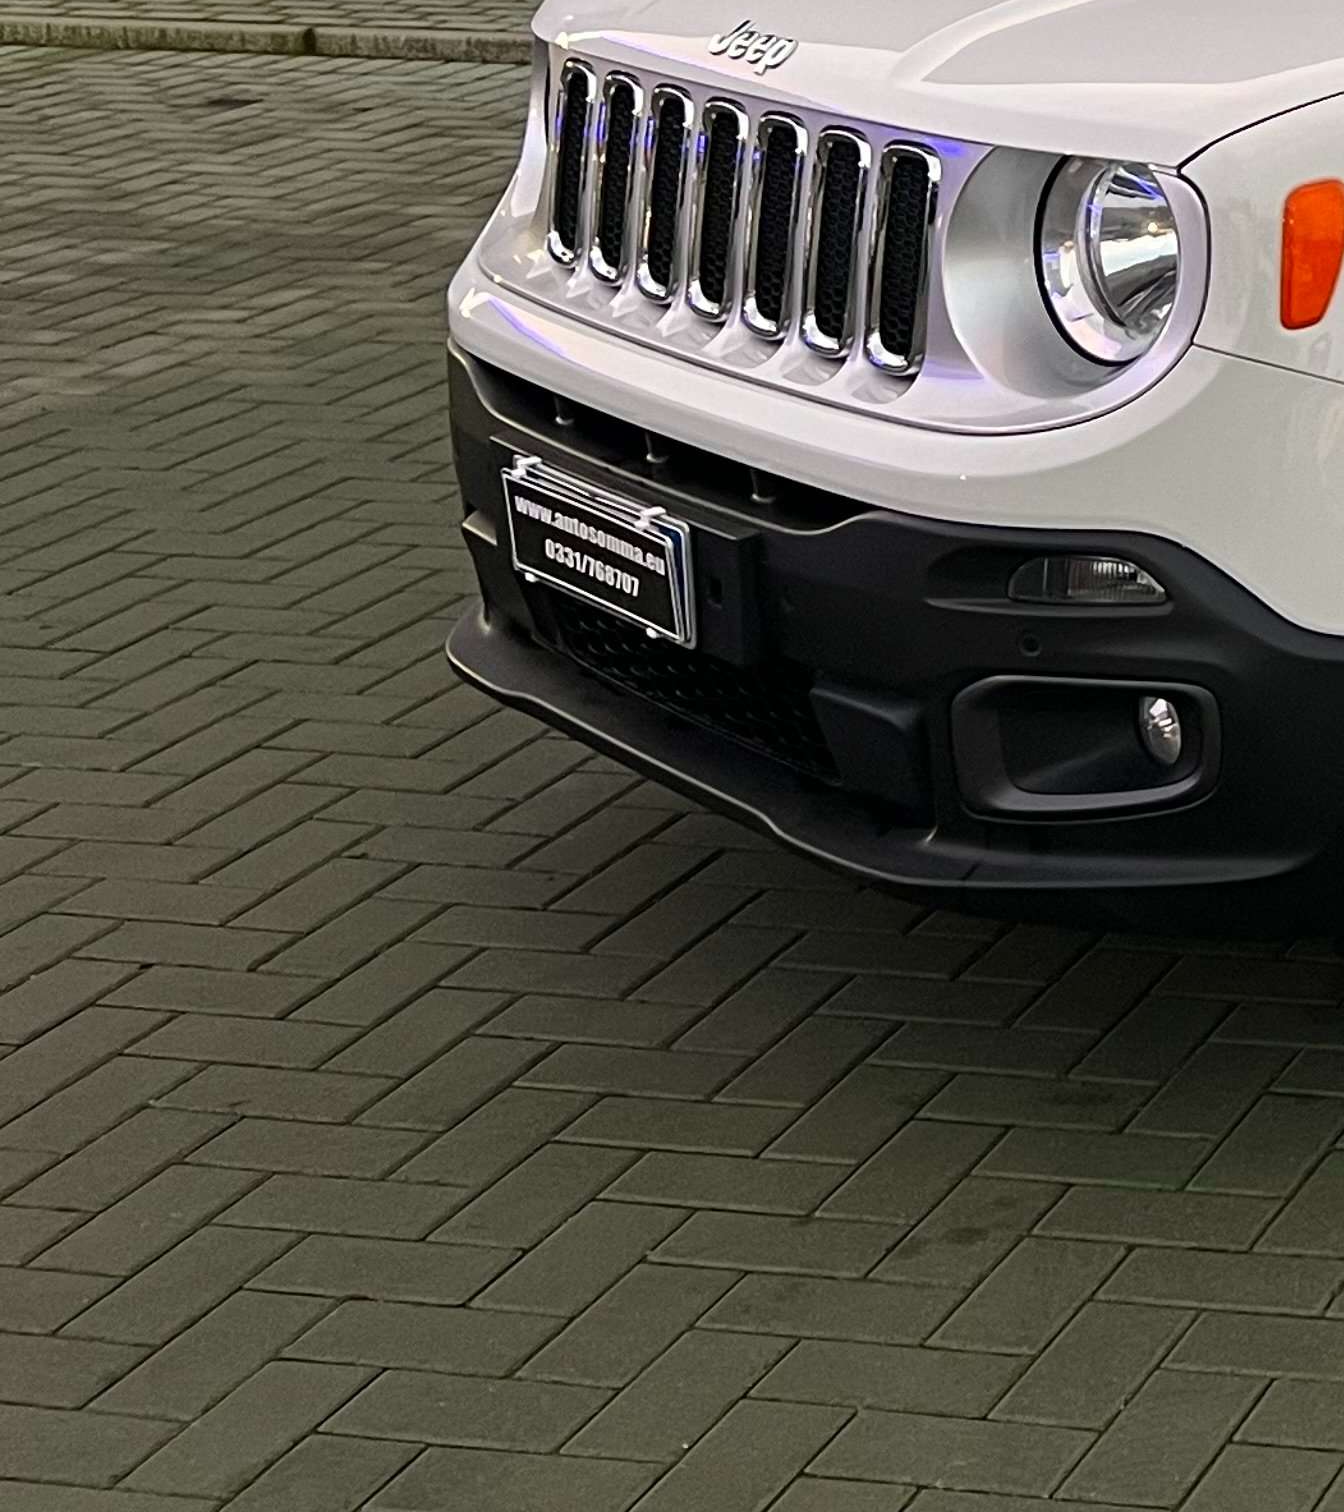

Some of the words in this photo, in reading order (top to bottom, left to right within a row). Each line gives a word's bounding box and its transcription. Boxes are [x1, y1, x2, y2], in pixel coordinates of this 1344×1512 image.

[707, 19, 799, 76] Jeep
[514, 495, 666, 576] www.autosomma.eu
[545, 538, 640, 597] 0331/768707
